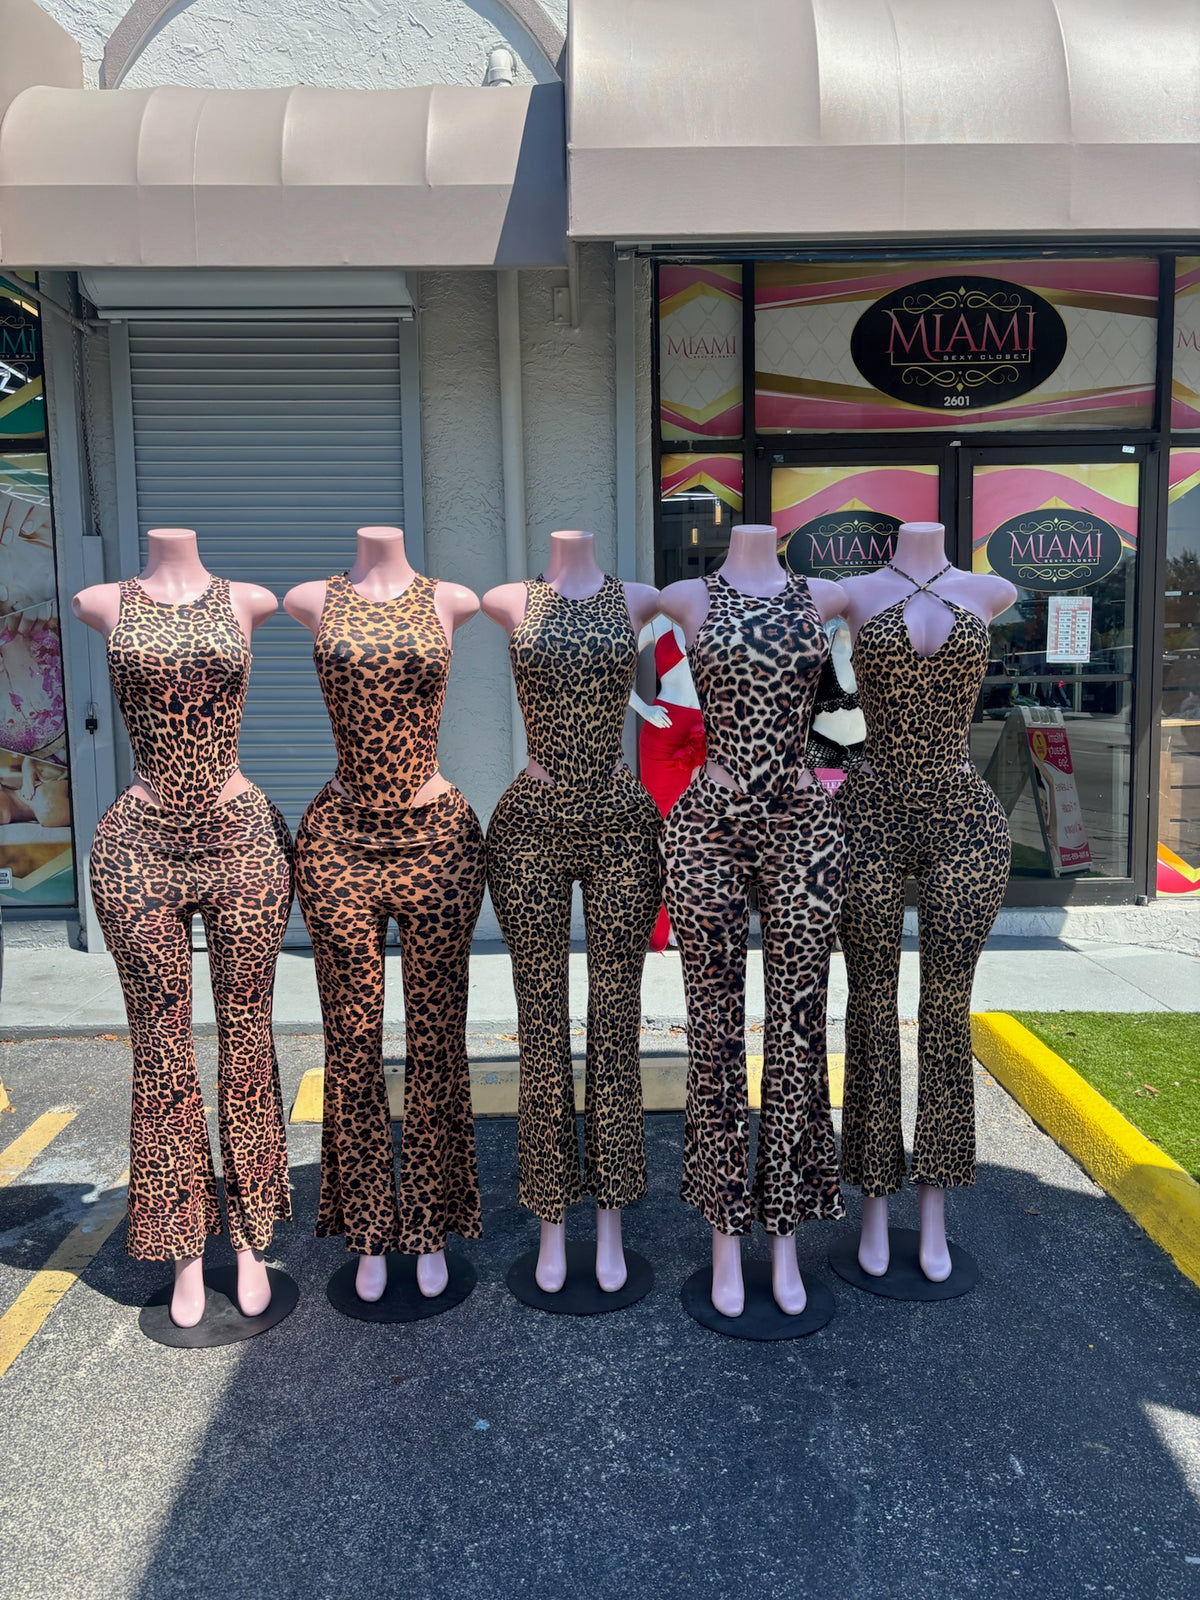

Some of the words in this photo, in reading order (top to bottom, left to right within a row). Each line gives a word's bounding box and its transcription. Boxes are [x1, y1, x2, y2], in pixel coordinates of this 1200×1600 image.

[666, 335, 736, 359] MIAMI
[881, 310, 1037, 361] MIAMI
[943, 395, 970, 407] 2601
[805, 533, 896, 566] MIAM
[1006, 531, 1103, 564] MIAMI
